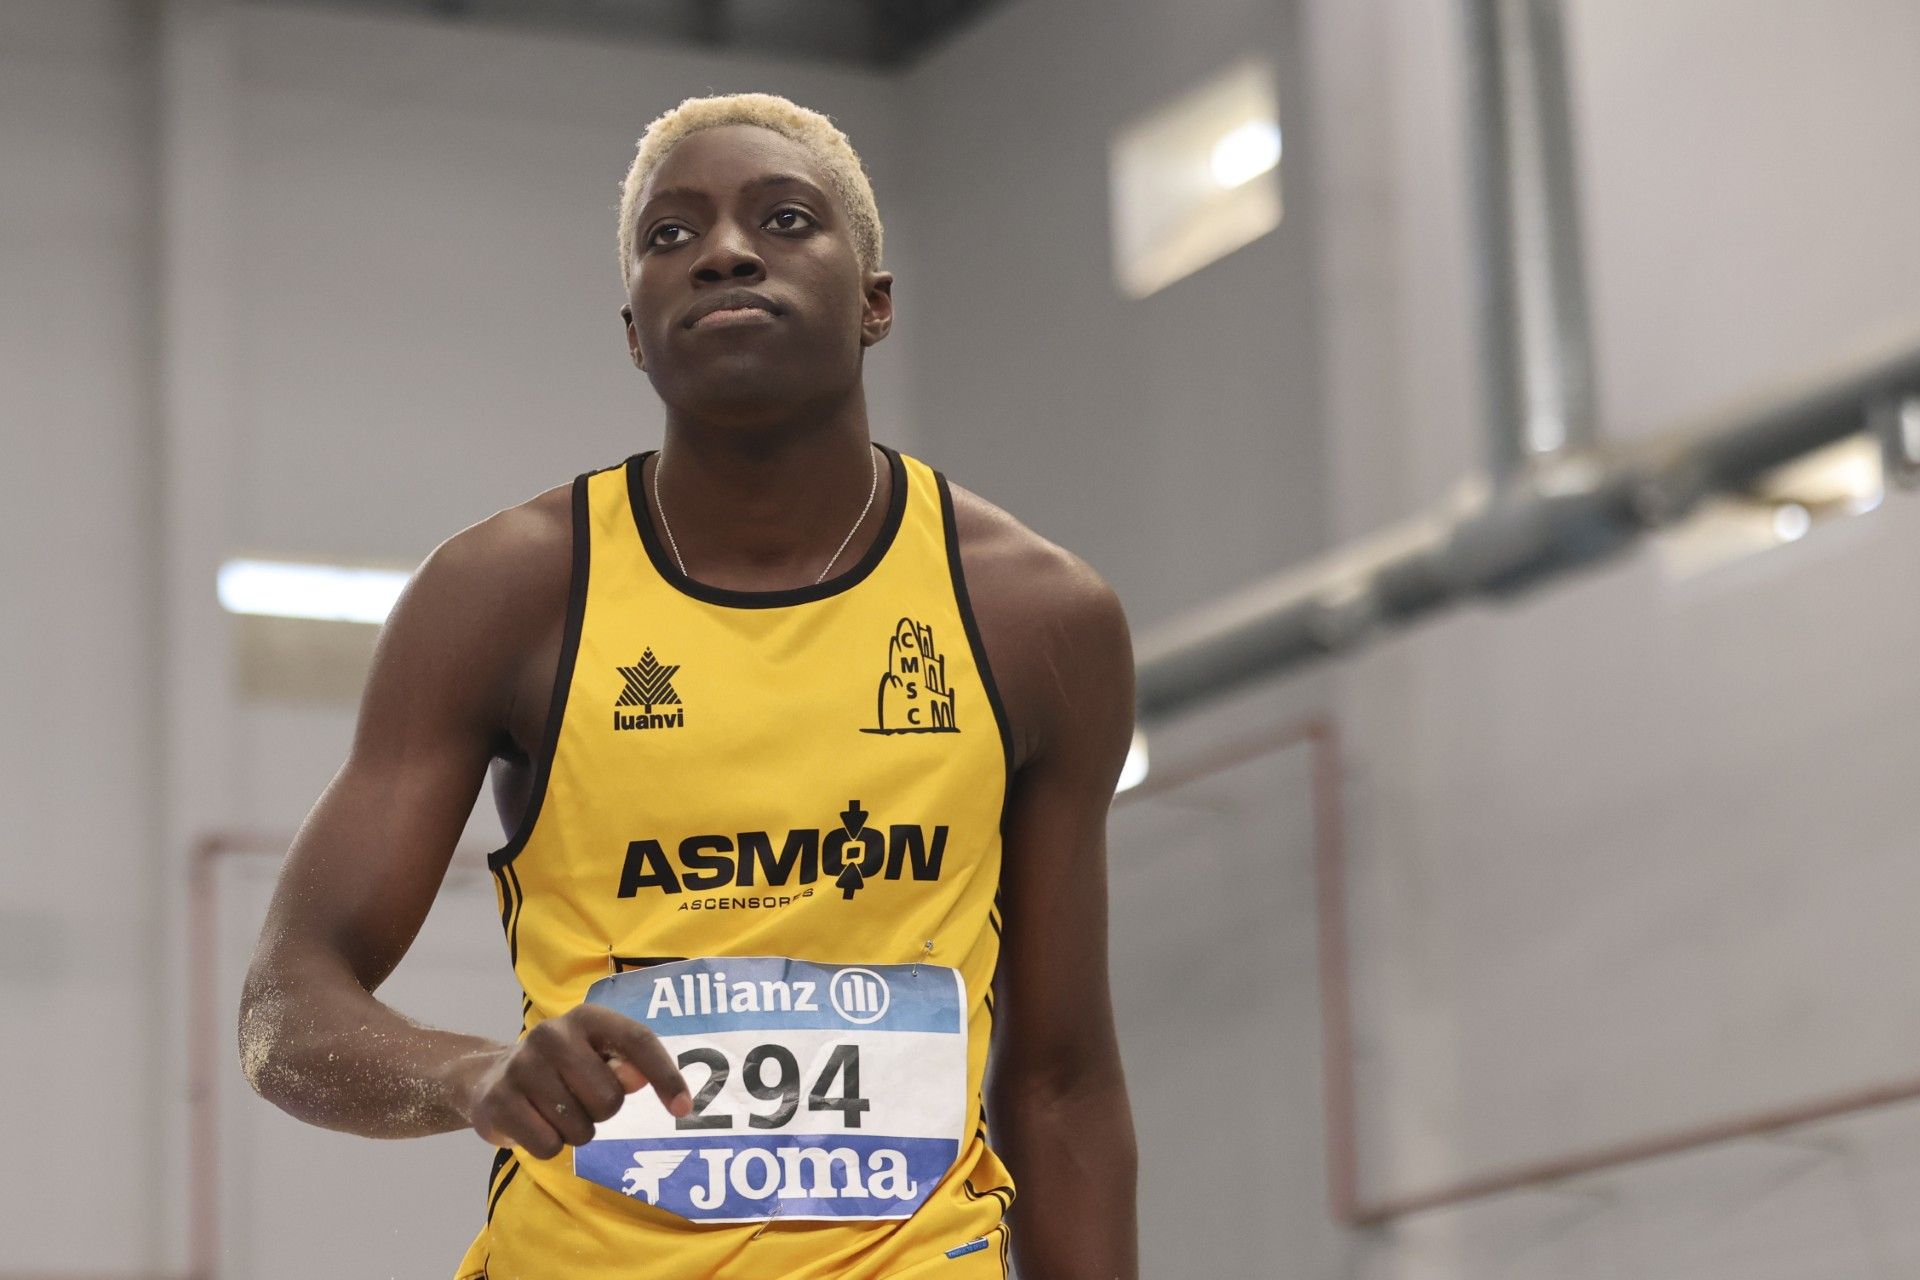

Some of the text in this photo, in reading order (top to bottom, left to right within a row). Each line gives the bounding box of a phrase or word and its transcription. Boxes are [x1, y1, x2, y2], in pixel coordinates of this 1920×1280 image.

[614, 708, 684, 731] luanvi
[617, 824, 949, 898] ASMON
[646, 972, 818, 1019] Allianz
[675, 1043, 870, 1131] 294
[690, 1146, 918, 1210] Joma
